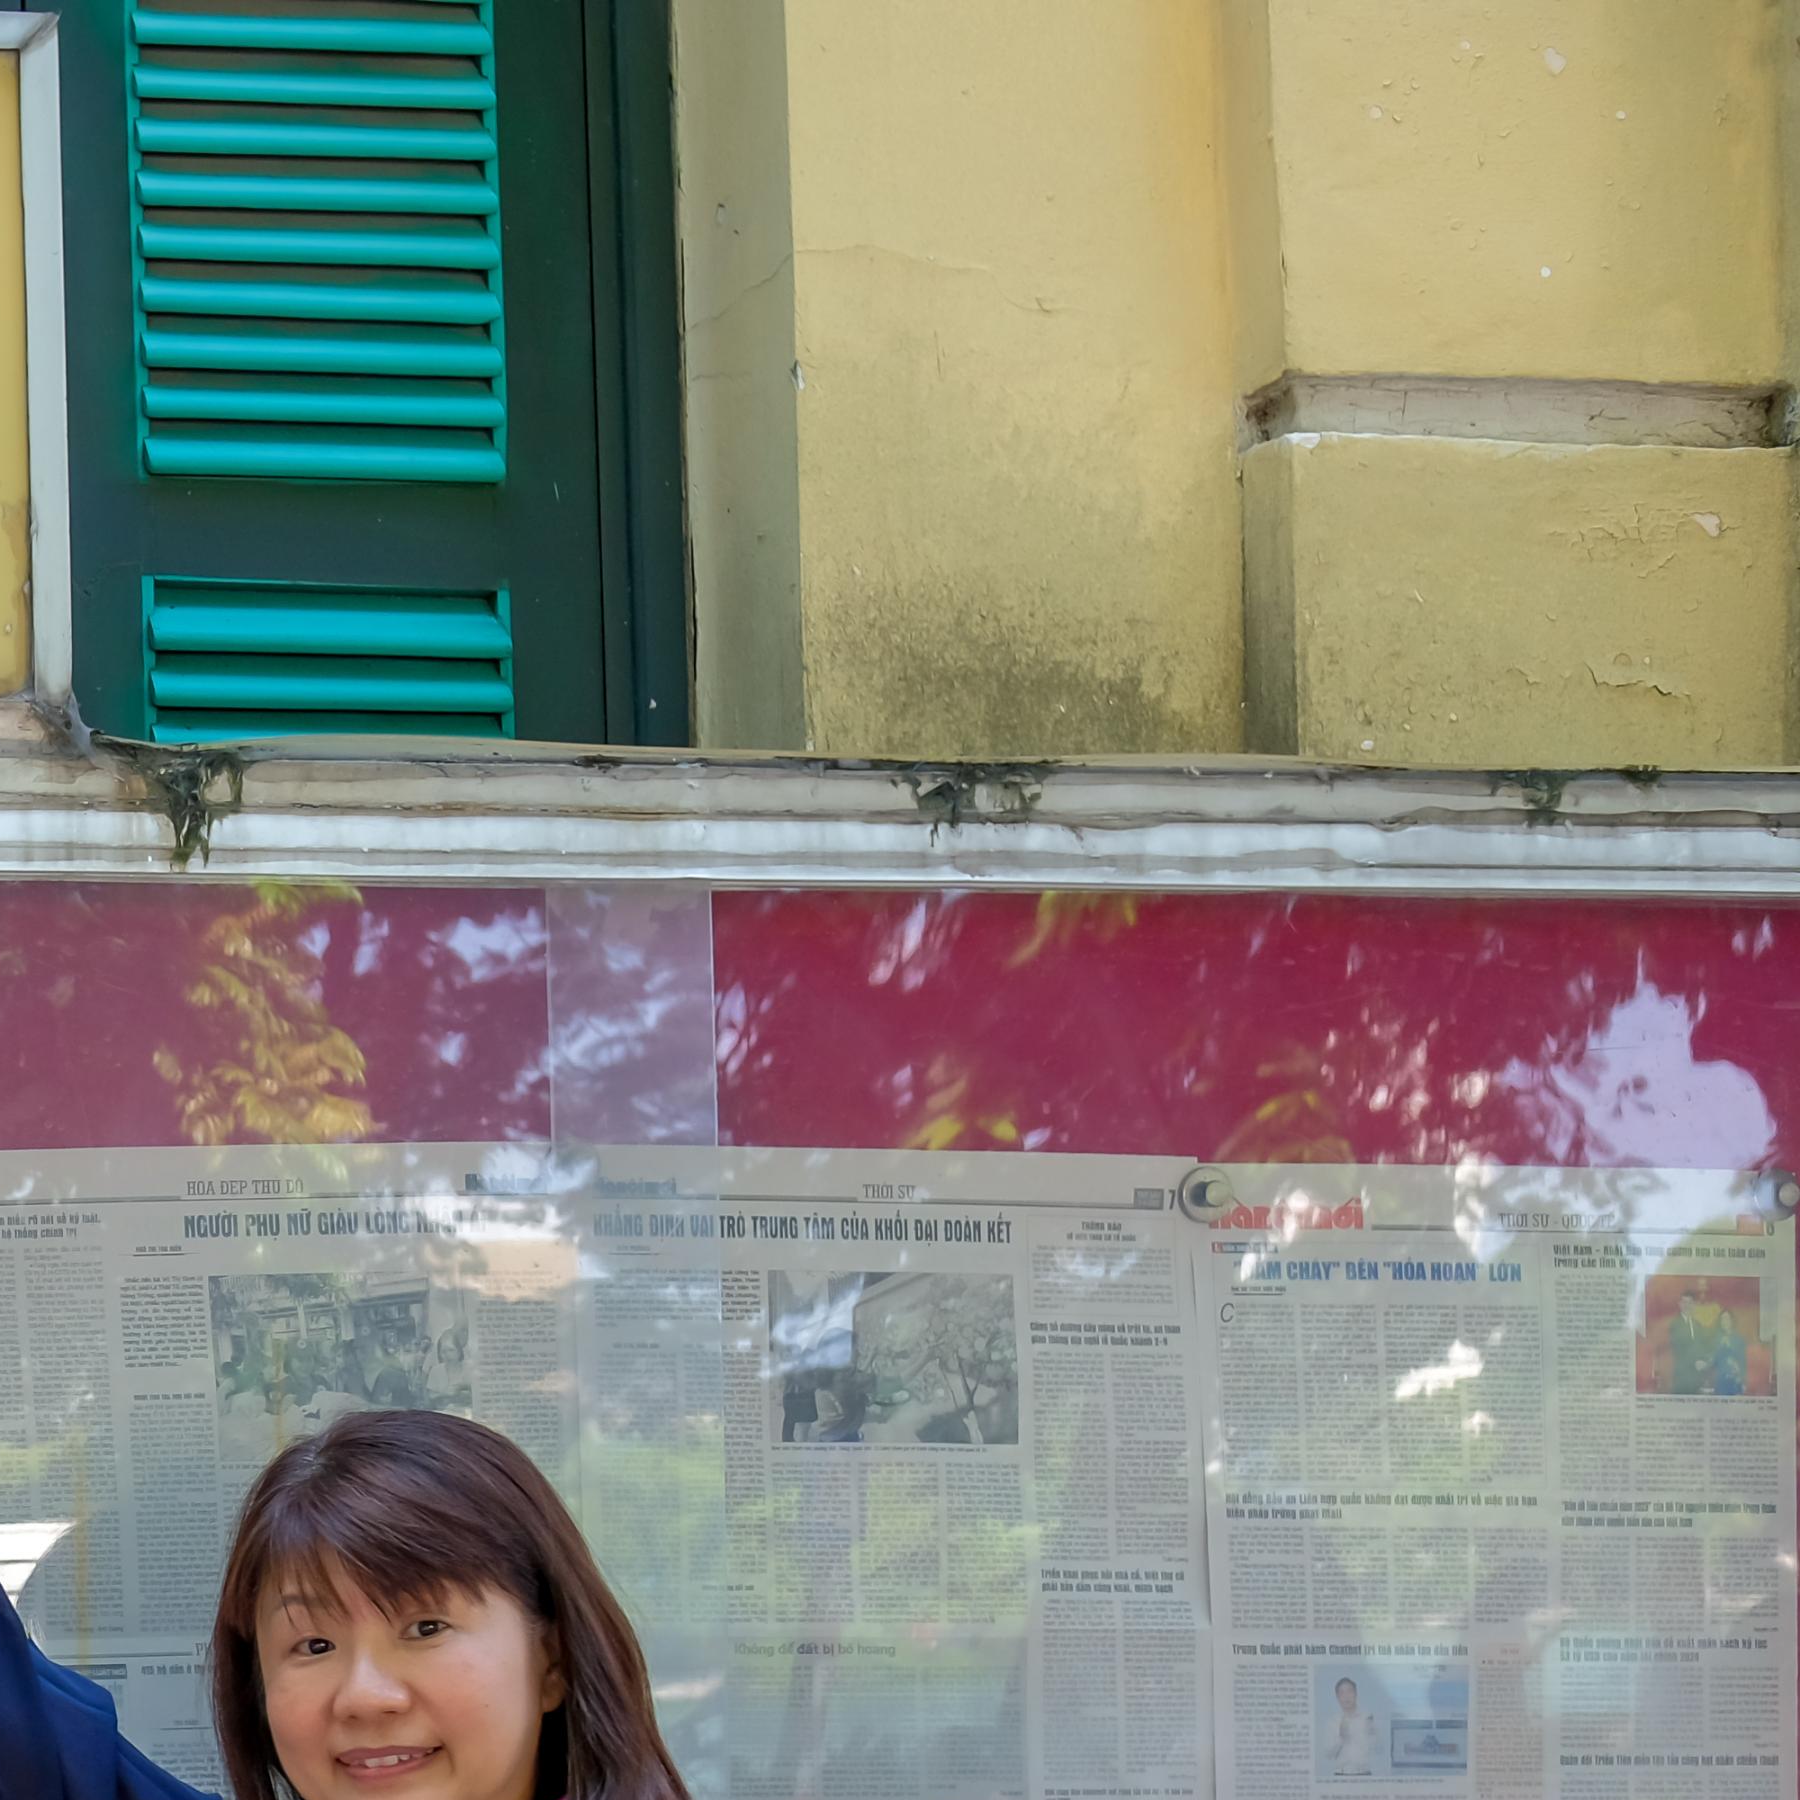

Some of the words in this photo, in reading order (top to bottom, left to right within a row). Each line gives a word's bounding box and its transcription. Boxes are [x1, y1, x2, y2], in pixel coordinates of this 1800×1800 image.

[187, 1180, 215, 1196] HOA
[1168, 1189, 1176, 1210] 7
[184, 1209, 238, 1239] NGƯỜI
[245, 1213, 280, 1241] PHỤ
[287, 1208, 311, 1235] NỮ
[317, 1207, 359, 1235] GIÀU
[690, 1215, 714, 1237] VAI
[719, 1210, 746, 1239] TRÒ
[751, 1215, 798, 1240] TRUNG
[803, 1212, 835, 1240] TÂM
[841, 1210, 869, 1241] CỦA
[875, 1209, 908, 1241] KHỐI
[914, 1218, 939, 1247] ĐẠI
[944, 1215, 981, 1243] ĐOÀN
[987, 1211, 1012, 1244] KẾT
[1346, 1258, 1378, 1280] BÊN
[1489, 1260, 1522, 1282] LỚN
[797, 1642, 818, 1655] đất
